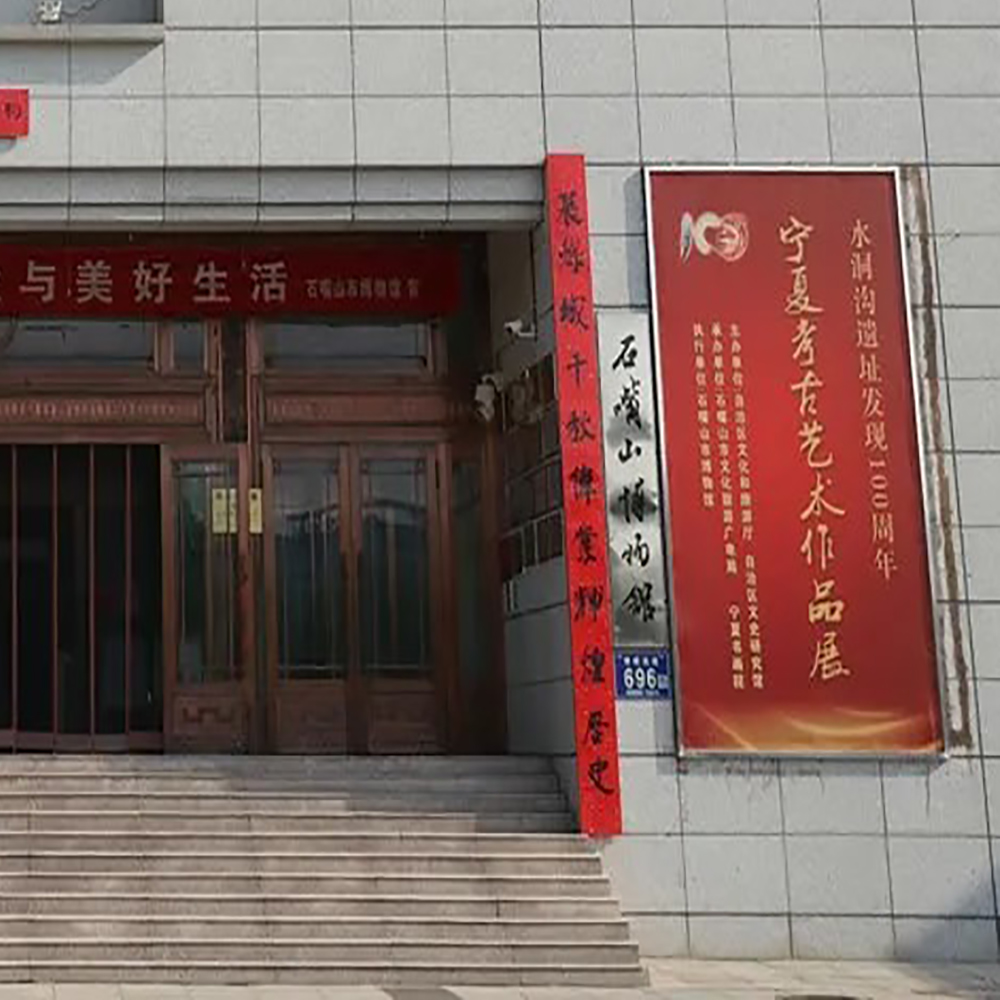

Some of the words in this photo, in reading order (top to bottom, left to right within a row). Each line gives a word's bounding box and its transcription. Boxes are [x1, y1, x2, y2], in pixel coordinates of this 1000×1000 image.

[779, 215, 851, 681] 宁夏考古艺术作品展
[850, 219, 898, 581] 水洞沟遗址发现100周年
[623, 667, 670, 689] 696
